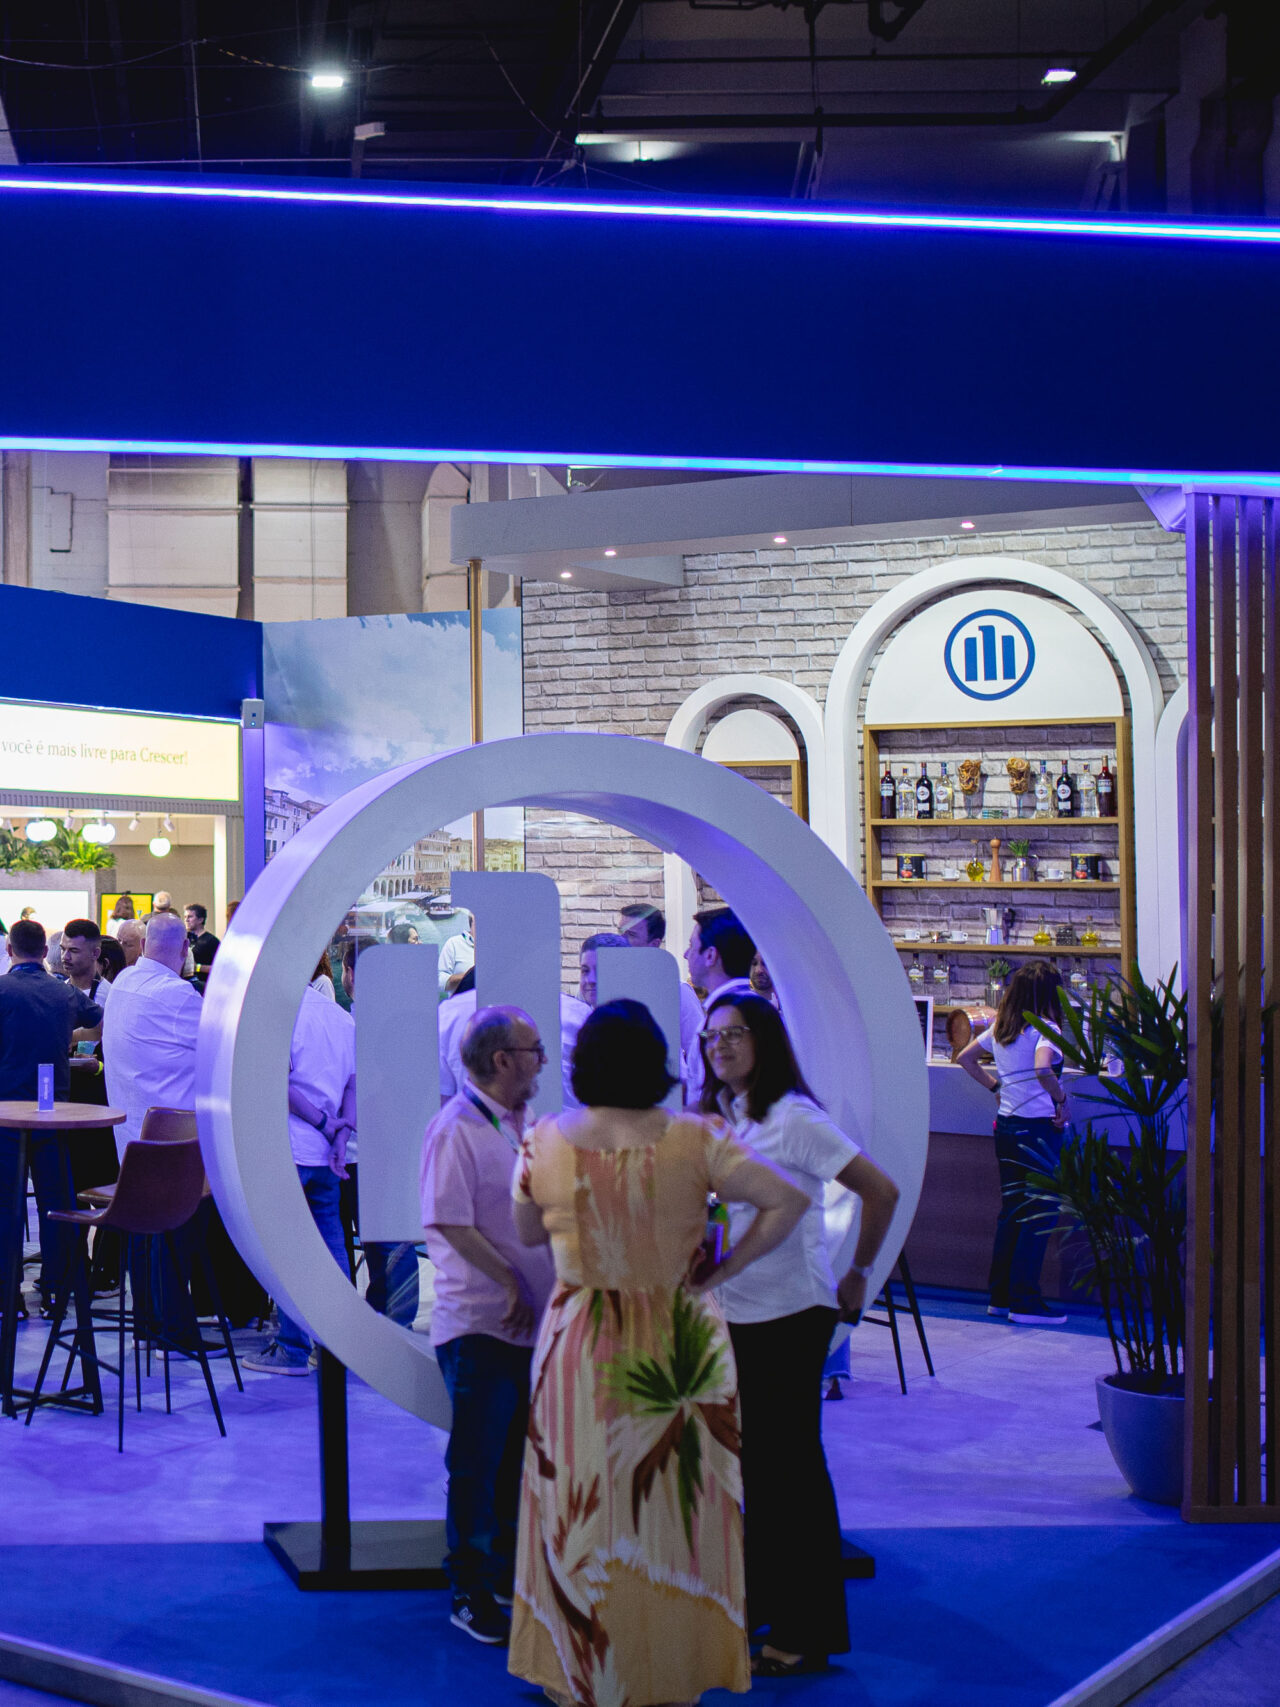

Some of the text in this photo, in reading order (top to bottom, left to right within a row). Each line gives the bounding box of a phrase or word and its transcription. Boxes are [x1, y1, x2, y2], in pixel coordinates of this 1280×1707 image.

[1, 738, 33, 755] você
[36, 739, 45, 755] é
[48, 743, 77, 758] mais
[80, 743, 107, 760] livre
[110, 747, 137, 764] para
[140, 746, 189, 766] Crescer!
